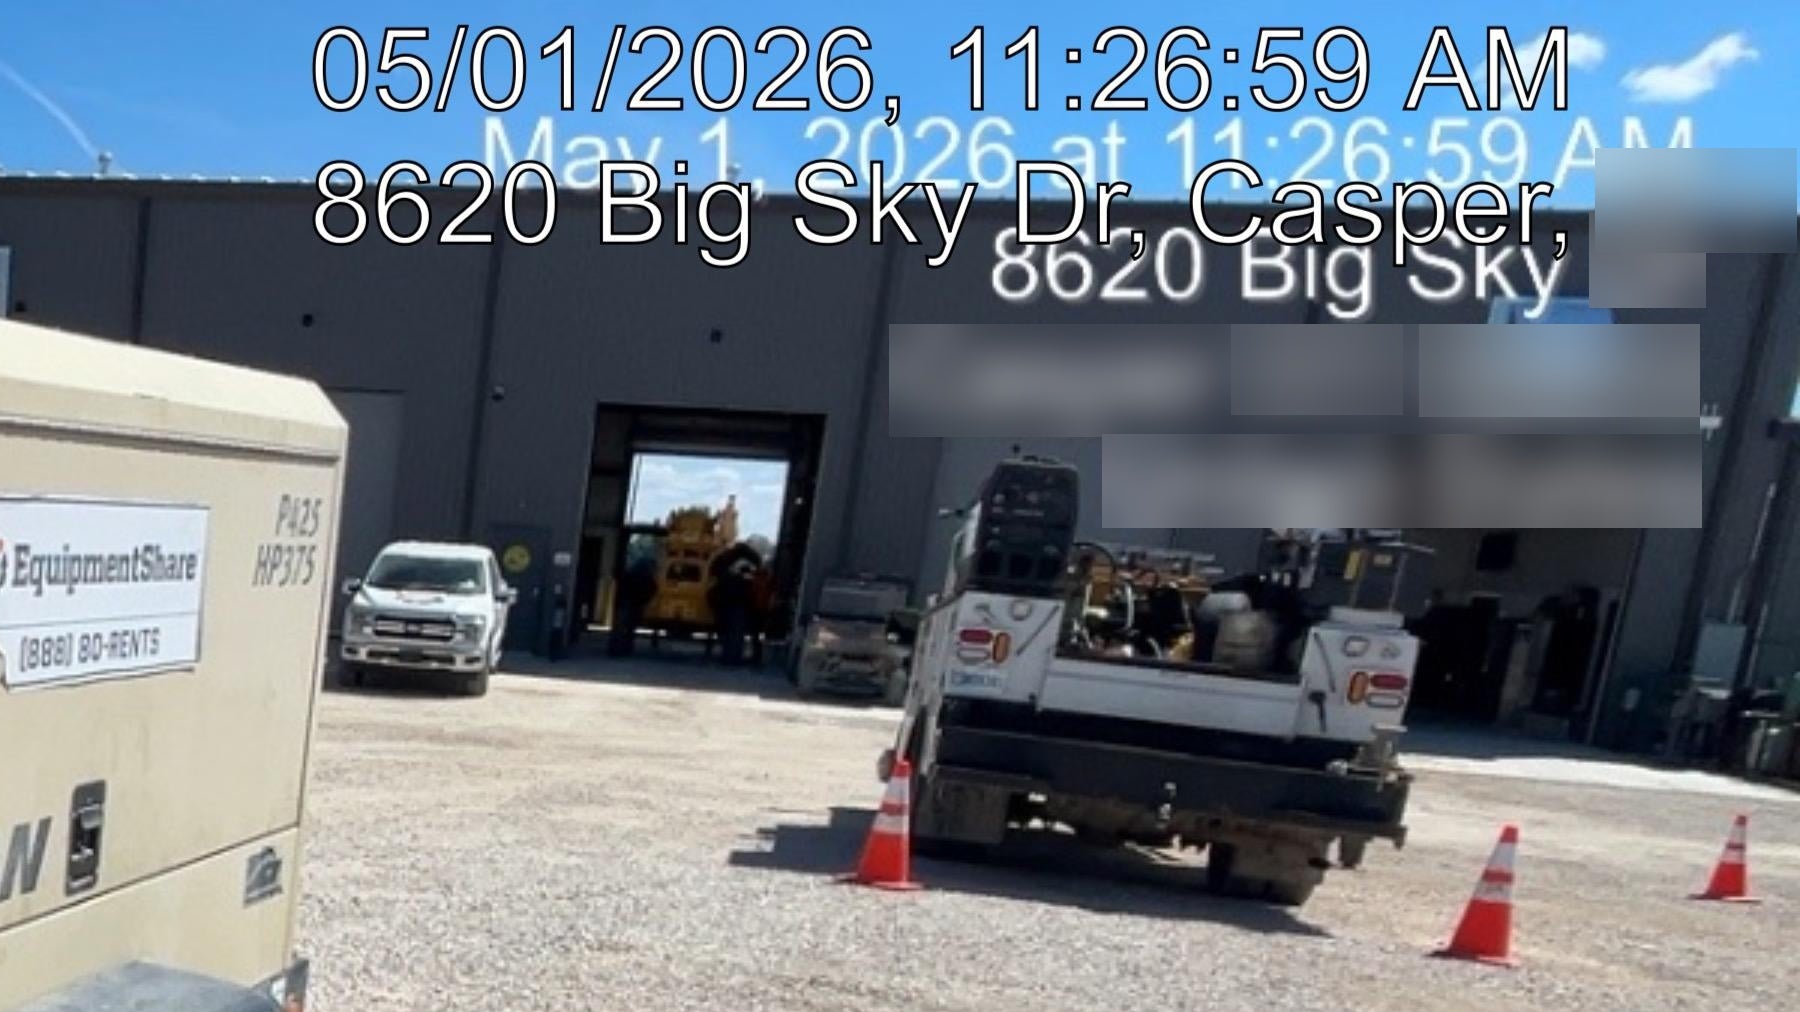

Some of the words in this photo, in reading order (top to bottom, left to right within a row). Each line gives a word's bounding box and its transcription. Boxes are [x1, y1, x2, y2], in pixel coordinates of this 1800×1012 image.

[275, 494, 323, 538] P425
[11, 543, 199, 598] EquipmentShare
[19, 632, 74, 673] (888)
[77, 627, 162, 664] 80-RENTS
